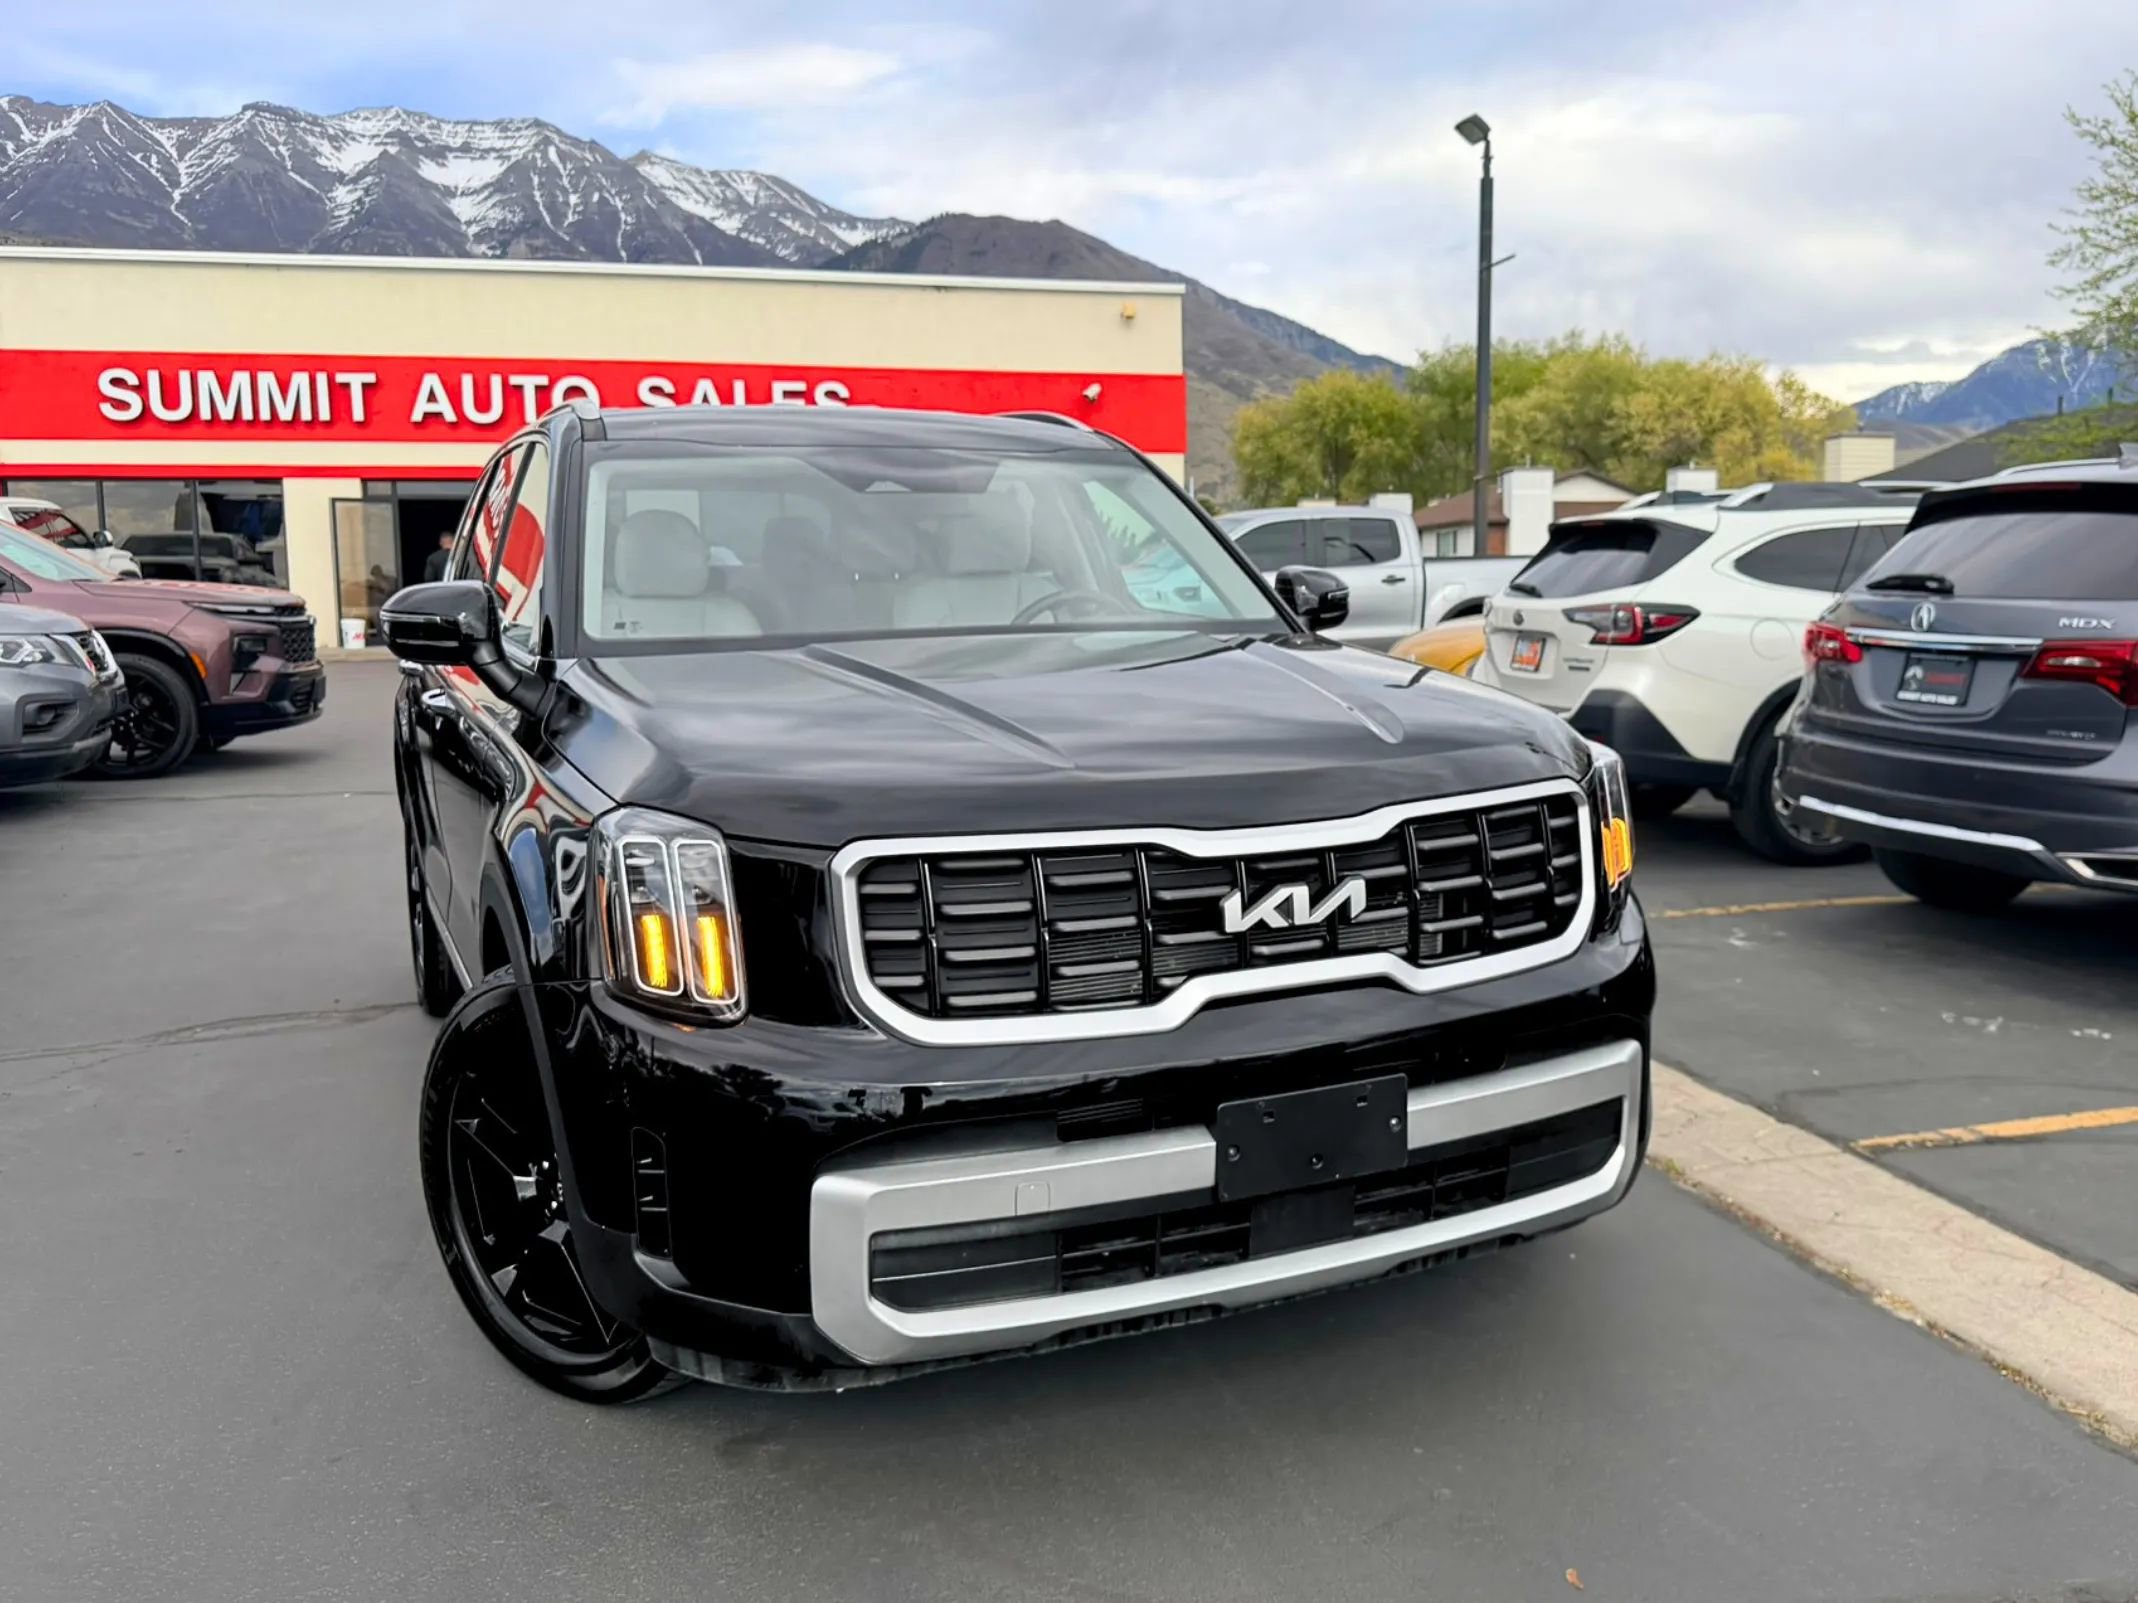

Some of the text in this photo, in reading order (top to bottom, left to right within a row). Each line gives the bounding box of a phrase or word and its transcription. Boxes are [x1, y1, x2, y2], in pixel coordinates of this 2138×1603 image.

[97, 367, 377, 423] SUMMIT
[410, 372, 600, 424] AUTO
[2058, 616, 2116, 630] MDX
[1221, 876, 1367, 933] KIA
